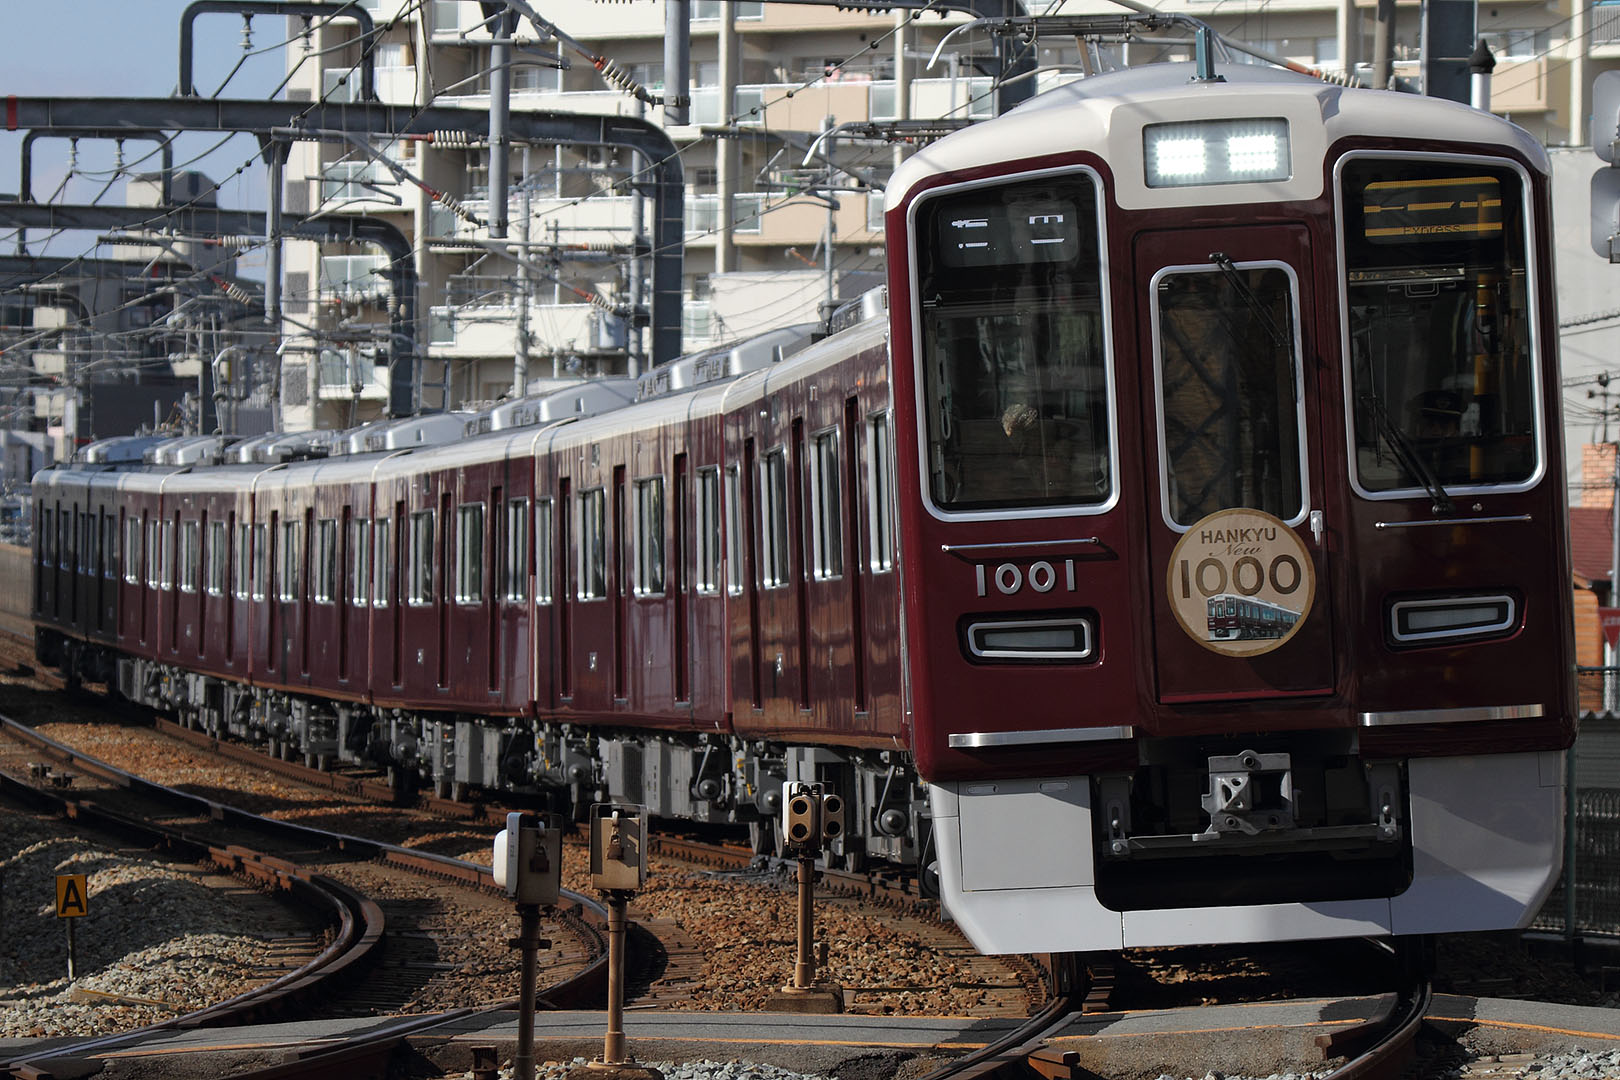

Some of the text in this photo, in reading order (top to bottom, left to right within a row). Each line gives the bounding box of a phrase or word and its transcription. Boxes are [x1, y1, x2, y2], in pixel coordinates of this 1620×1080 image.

[1201, 527, 1276, 544] HANKYU
[1209, 542, 1263, 557] New
[976, 559, 1075, 597] 1001
[1180, 554, 1301, 599] 1000
[61, 879, 85, 914] A
